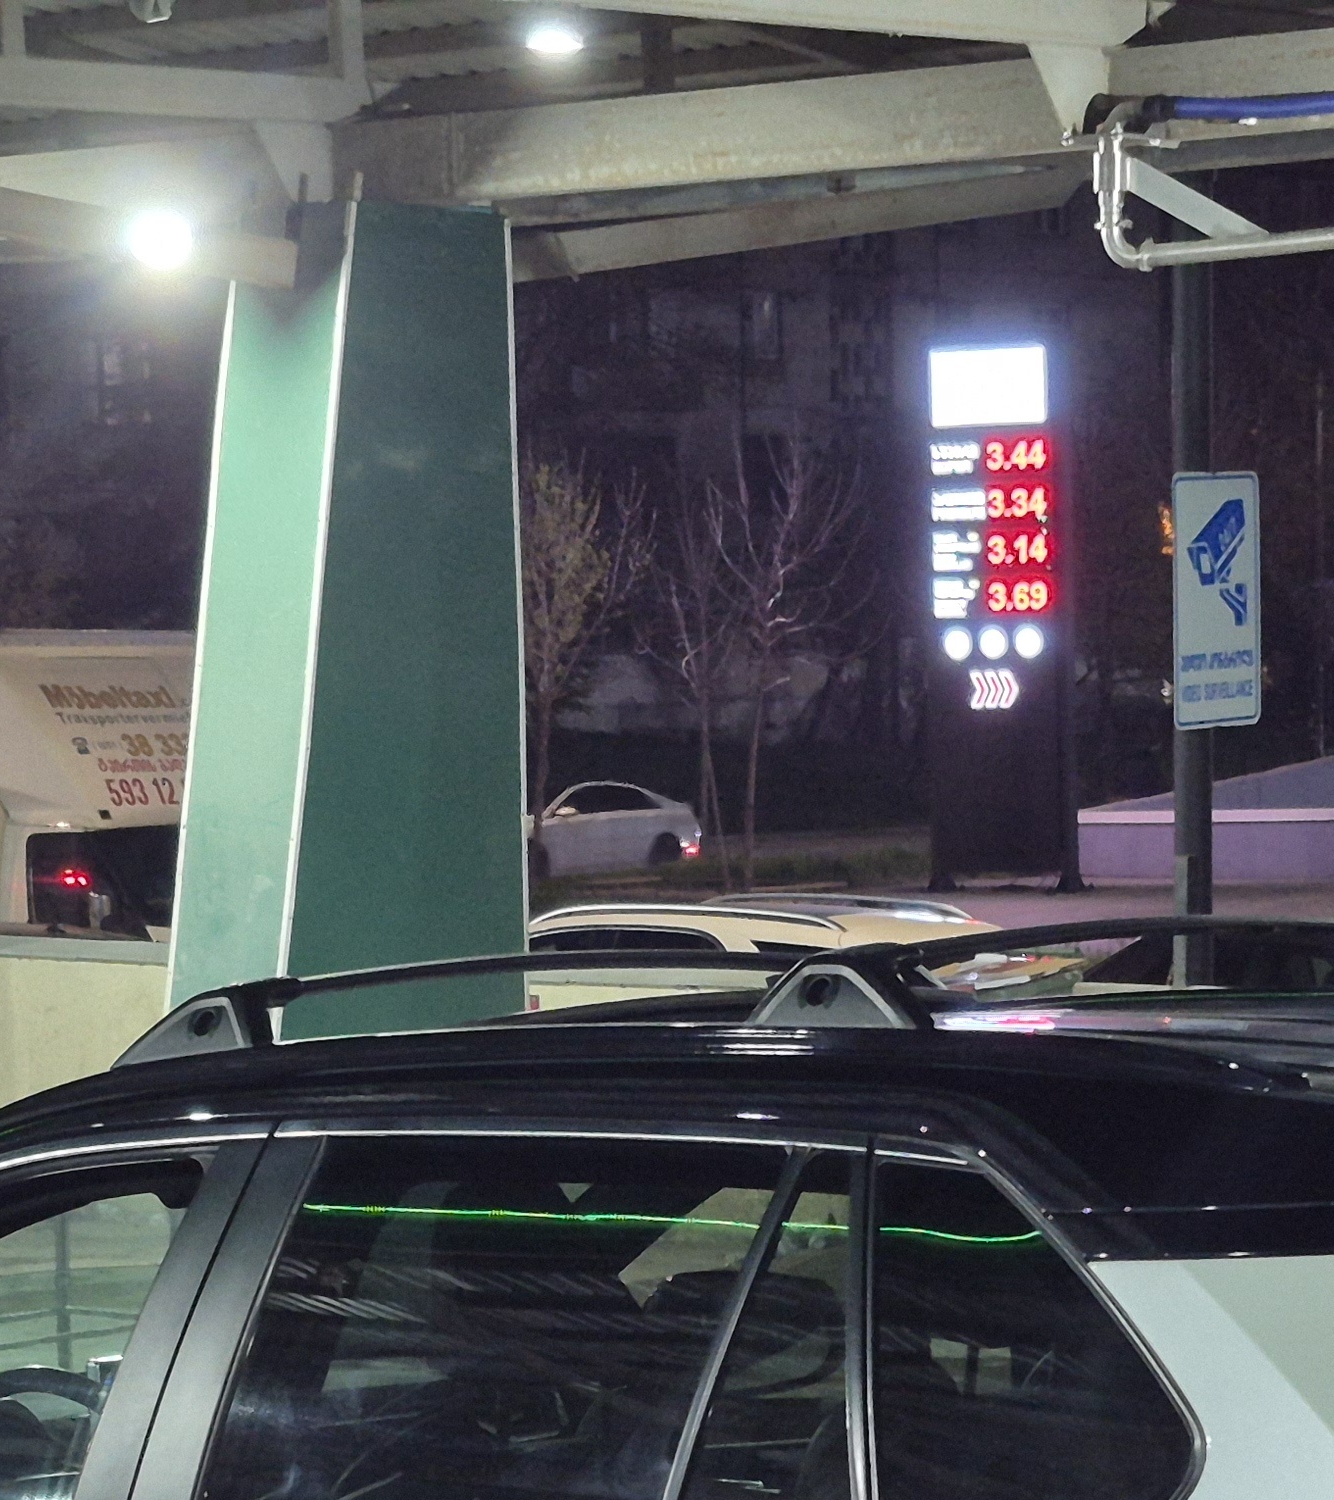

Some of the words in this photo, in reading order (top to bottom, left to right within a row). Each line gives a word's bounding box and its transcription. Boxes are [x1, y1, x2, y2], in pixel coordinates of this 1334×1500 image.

[986, 439, 1046, 471] 3.44
[987, 487, 1047, 519] 3.34
[987, 534, 1048, 565] 3.14
[987, 580, 1048, 612] 3.69
[120, 733, 154, 757] 38
[105, 778, 150, 807] 593
[152, 777, 180, 806] 12
